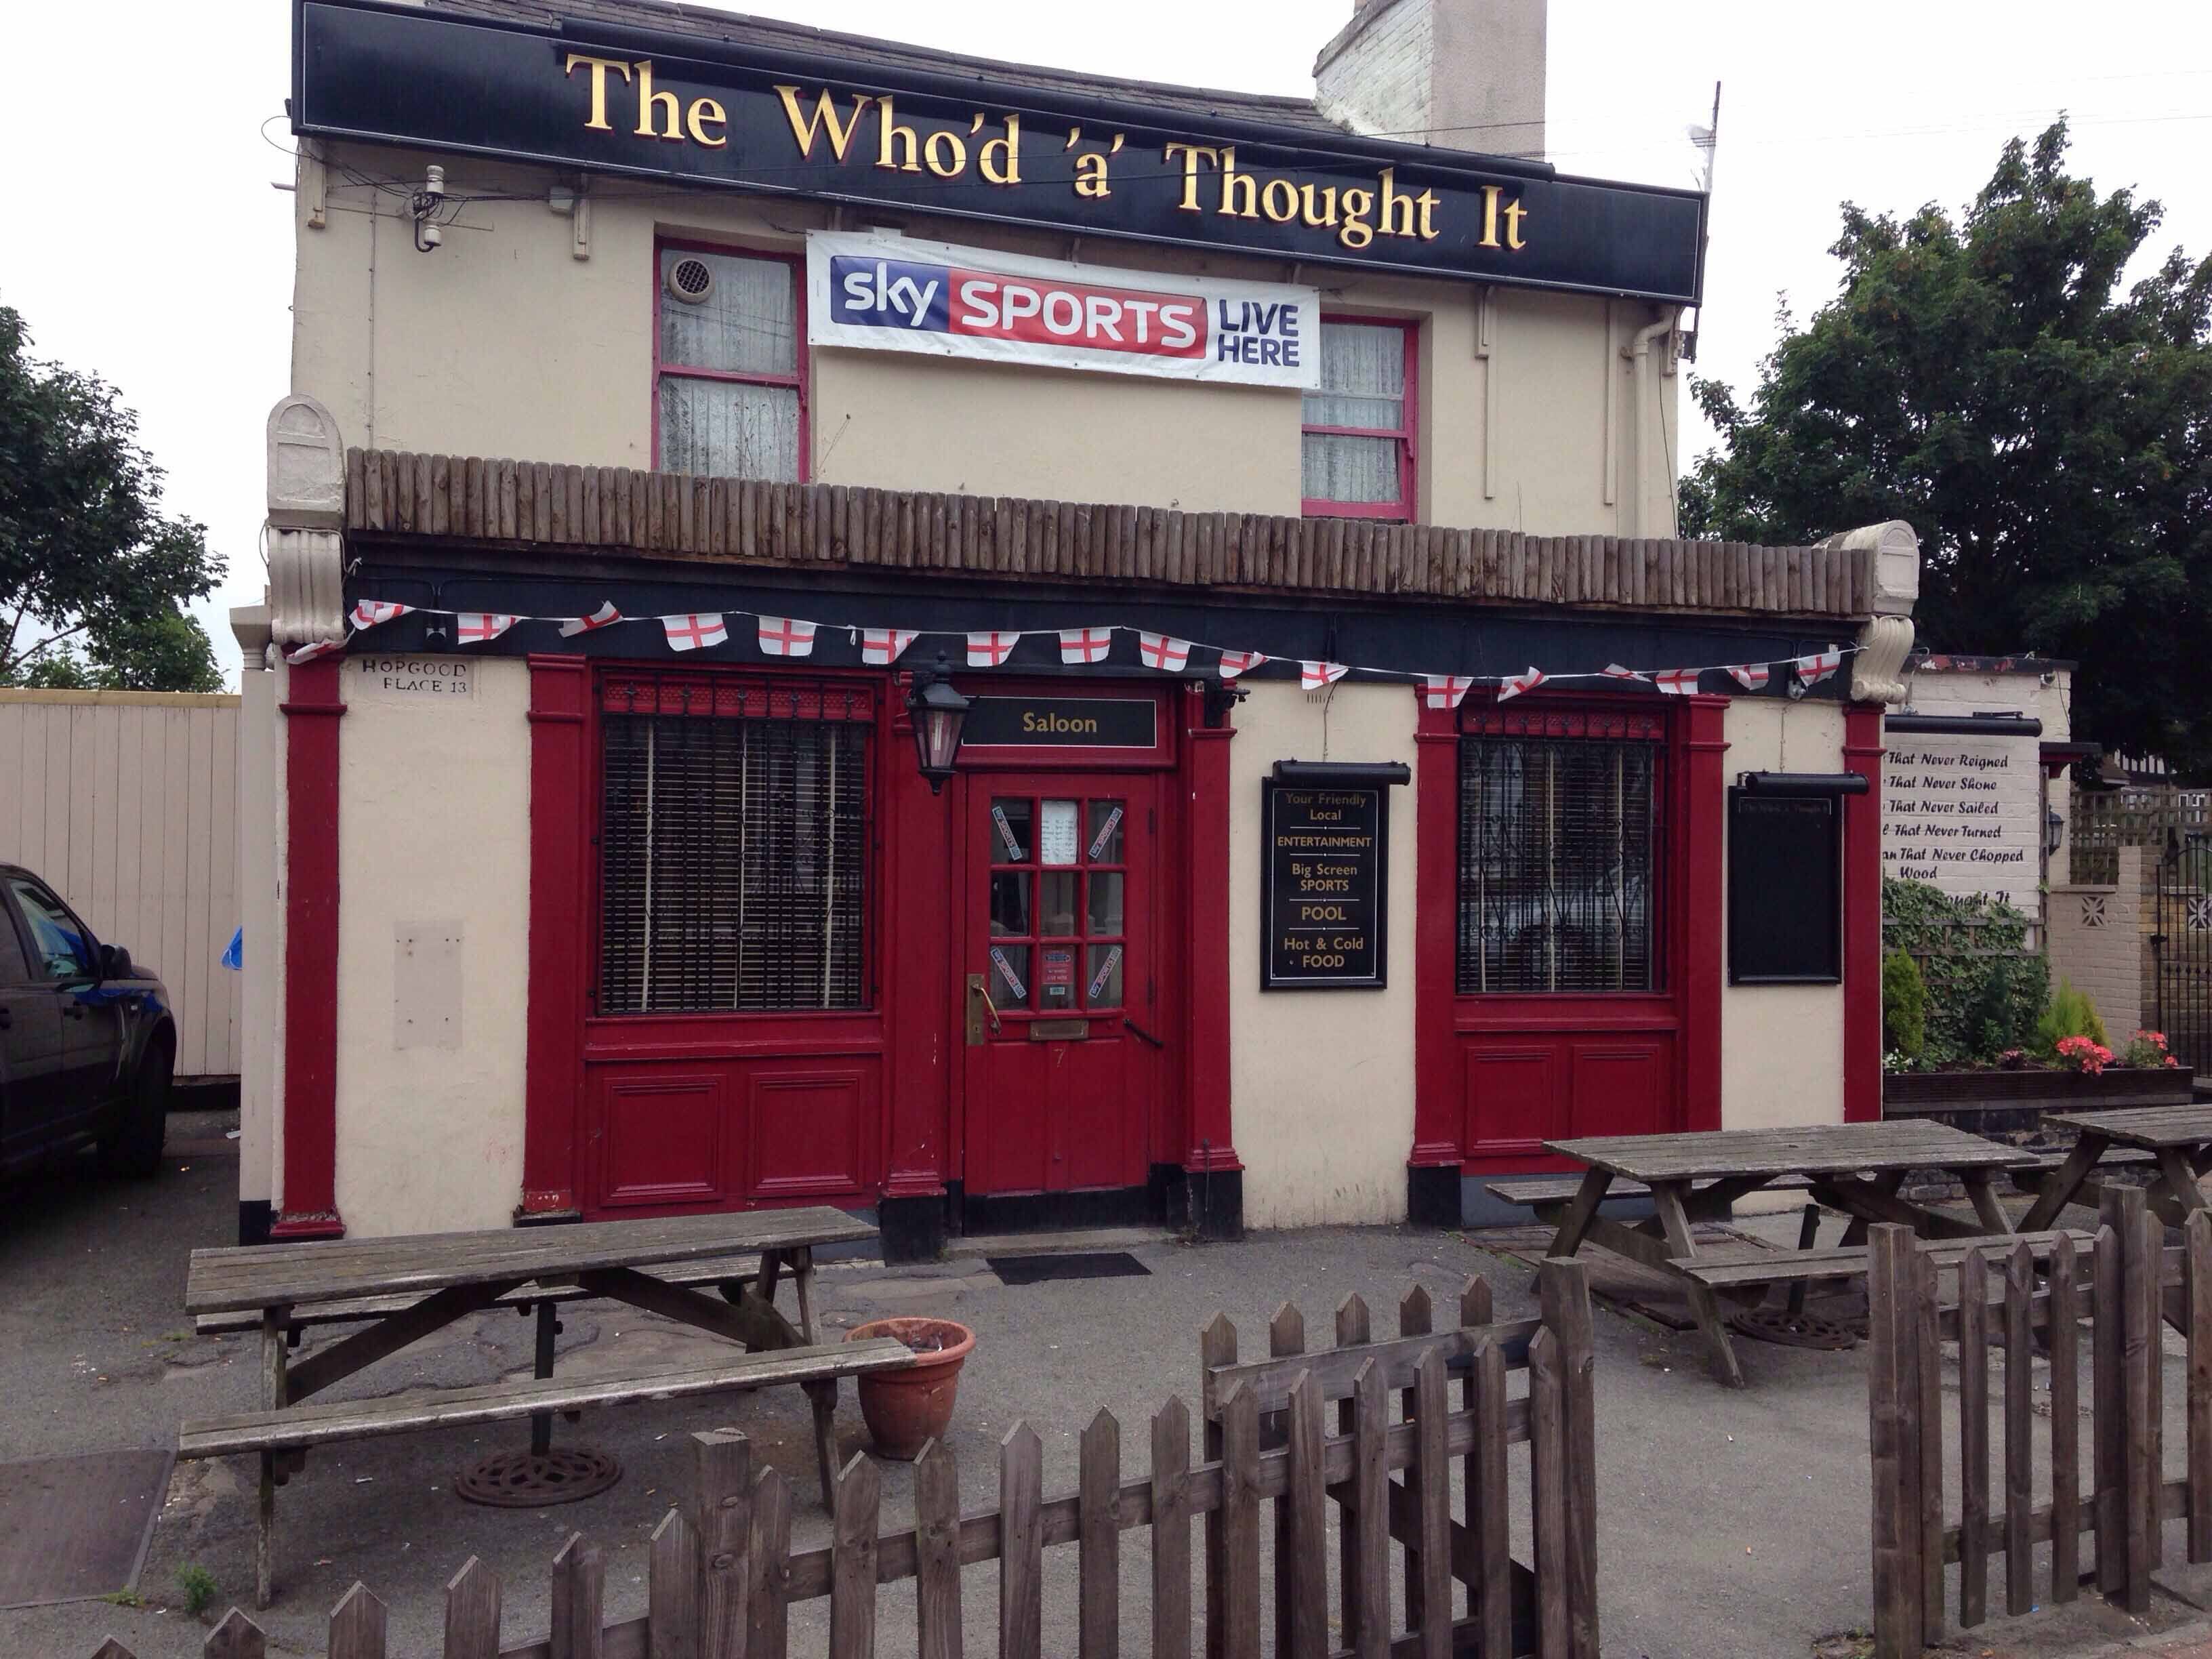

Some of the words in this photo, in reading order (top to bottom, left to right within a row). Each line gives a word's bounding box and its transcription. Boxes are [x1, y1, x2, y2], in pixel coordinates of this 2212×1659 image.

[565, 54, 727, 146] The
[773, 84, 1022, 185] Who'd
[1165, 141, 1441, 249] Thought
[1479, 185, 1528, 250] It
[843, 262, 939, 327] sky
[960, 281, 1197, 348] SPORTS
[1219, 299, 1300, 337] LIVE
[1217, 333, 1300, 368] HERE
[450, 682, 467, 693] 13
[1023, 712, 1098, 733] Saloon
[1889, 752, 1915, 765] That
[1921, 753, 1955, 766] Never
[1959, 754, 2009, 771] Reigned
[1889, 775, 1917, 789] That
[1922, 777, 1956, 790] Never
[1960, 777, 1997, 790] Shone
[1286, 792, 1313, 805] Your
[1318, 793, 1366, 807] Friendly
[1310, 808, 1342, 821] Local
[1889, 800, 1916, 813] That
[1920, 800, 1955, 813] Never
[1959, 801, 1999, 815] Sailed
[1895, 823, 1921, 837] That
[1925, 824, 1959, 838] Never
[1962, 825, 2001, 838] Turned
[1277, 836, 1372, 848] ENTERTAINMENT
[1900, 847, 1926, 861] That
[1931, 848, 1967, 862] Never
[1969, 848, 2024, 864] Chopped
[1292, 863, 1311, 878] Big
[1317, 863, 1358, 876] Screen
[1900, 866, 1938, 880] Wood
[1300, 880, 1349, 892] SPORTS
[1301, 906, 1347, 921] POOL
[1284, 937, 1310, 950] Hot
[1315, 937, 1328, 950] &
[1332, 937, 1364, 950] Cold
[1302, 954, 1345, 968] FOOD
